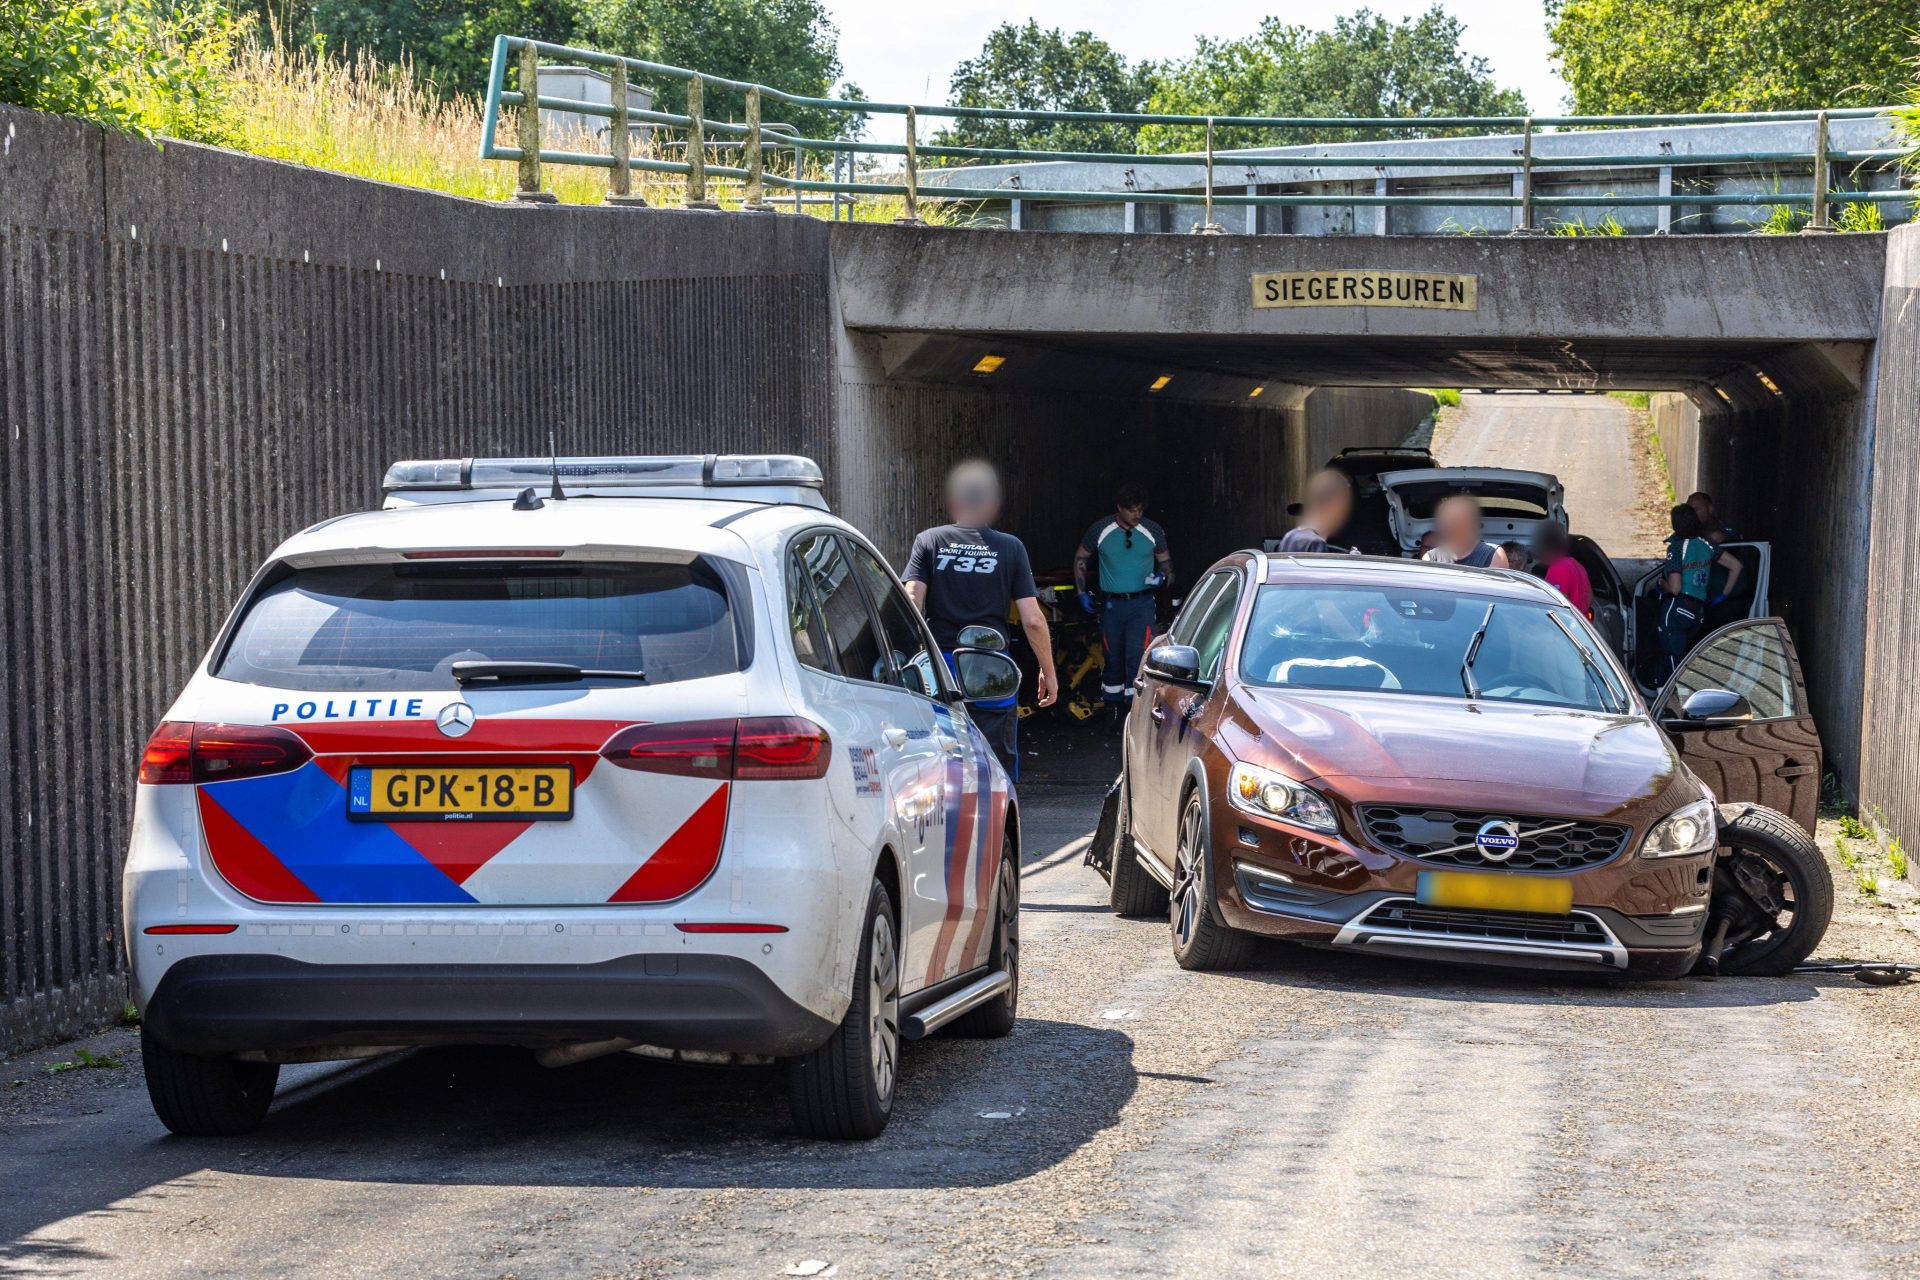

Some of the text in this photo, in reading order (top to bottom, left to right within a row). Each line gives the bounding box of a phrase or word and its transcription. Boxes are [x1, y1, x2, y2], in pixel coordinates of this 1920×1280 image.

[1264, 276, 1465, 303] SIEGERSBUREN
[938, 547, 999, 558] SPORT TOURING
[936, 554, 999, 574] T33
[271, 698, 423, 721] POLITIE
[386, 774, 555, 808] GPK-18-B
[353, 796, 368, 806] NL
[444, 812, 473, 821] politie.nl
[1480, 836, 1516, 845] VOLVO
